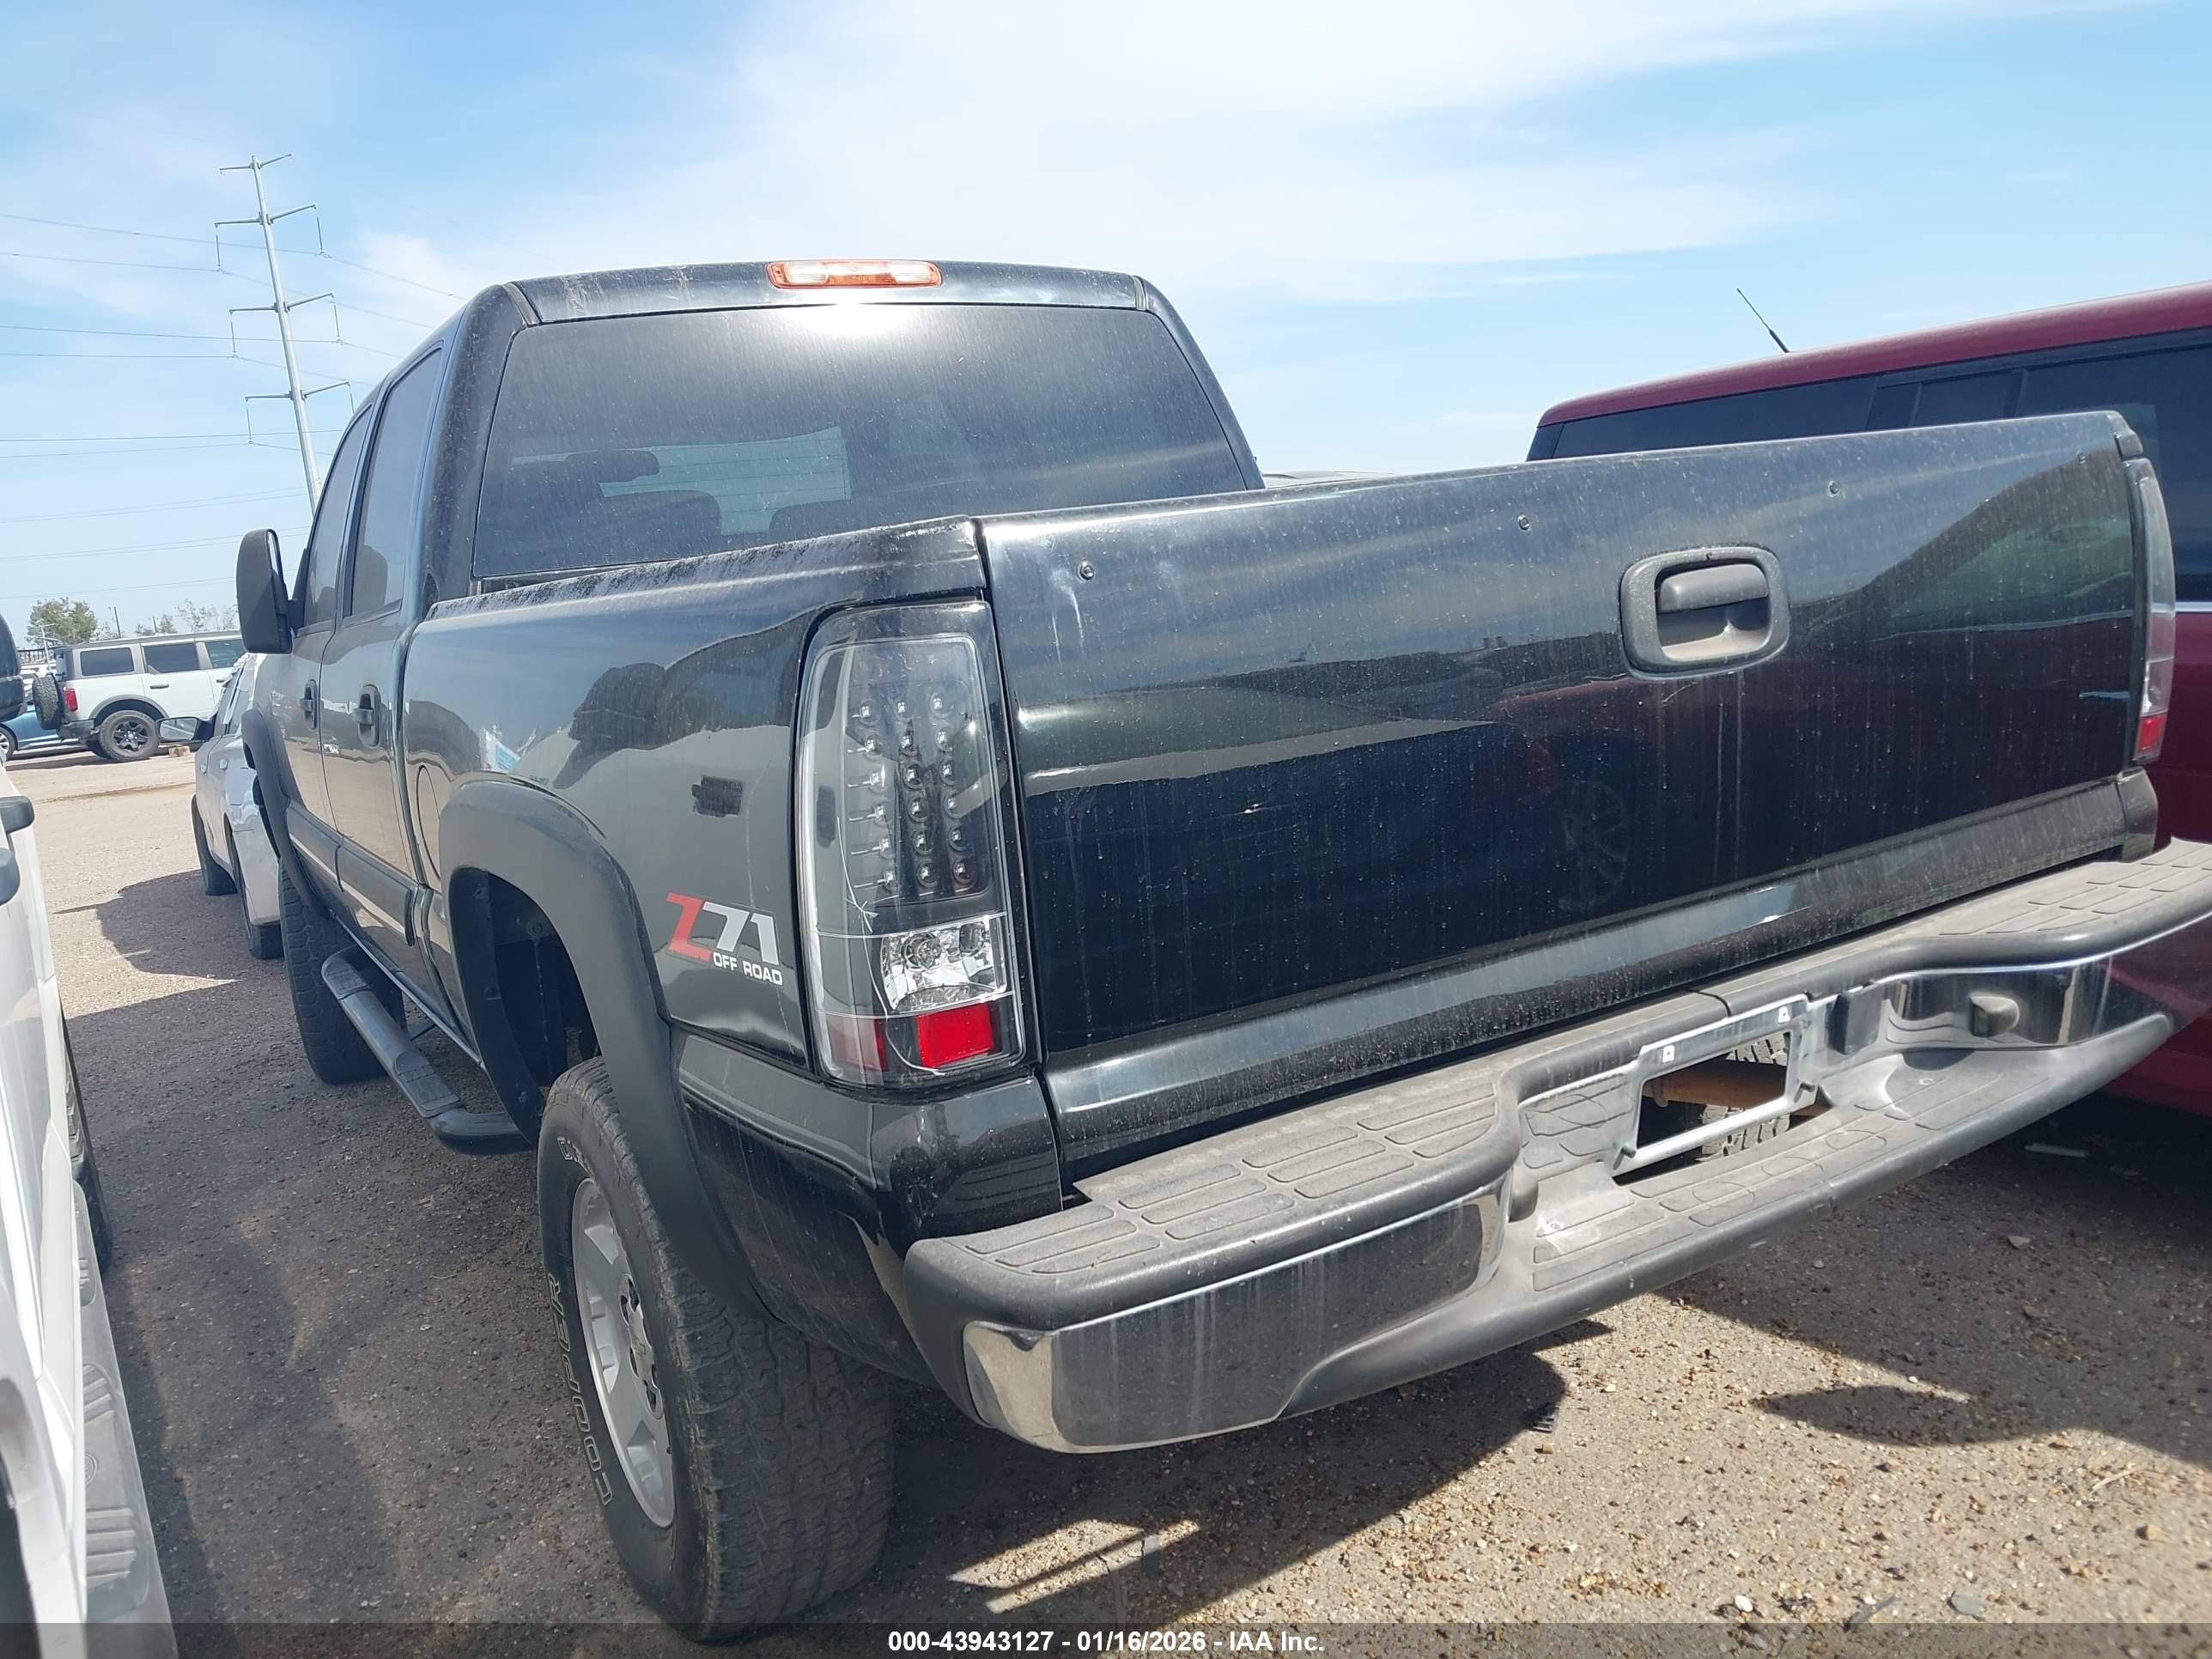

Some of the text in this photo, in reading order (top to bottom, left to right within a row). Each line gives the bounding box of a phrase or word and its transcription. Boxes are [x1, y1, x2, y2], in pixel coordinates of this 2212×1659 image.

[666, 893, 780, 966] Z71
[713, 951, 783, 986] OFF ROAD
[548, 1273, 613, 1505] COOPER
